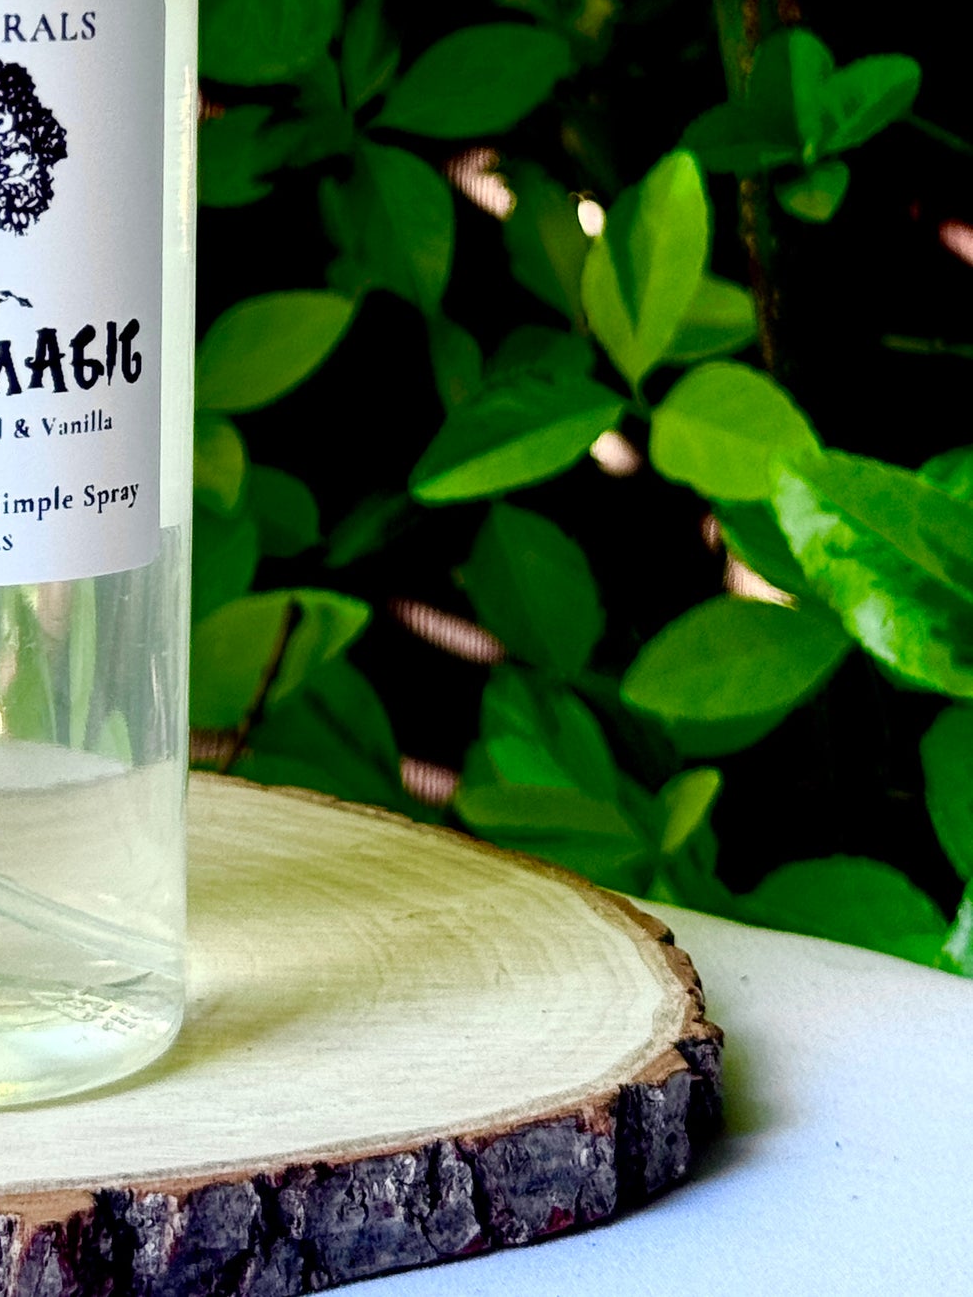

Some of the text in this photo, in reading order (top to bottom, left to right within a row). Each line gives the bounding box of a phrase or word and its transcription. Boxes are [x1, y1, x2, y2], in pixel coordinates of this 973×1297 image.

[13, 418, 31, 439] &
[41, 408, 113, 436] Vanilla
[82, 482, 140, 514] Spray
